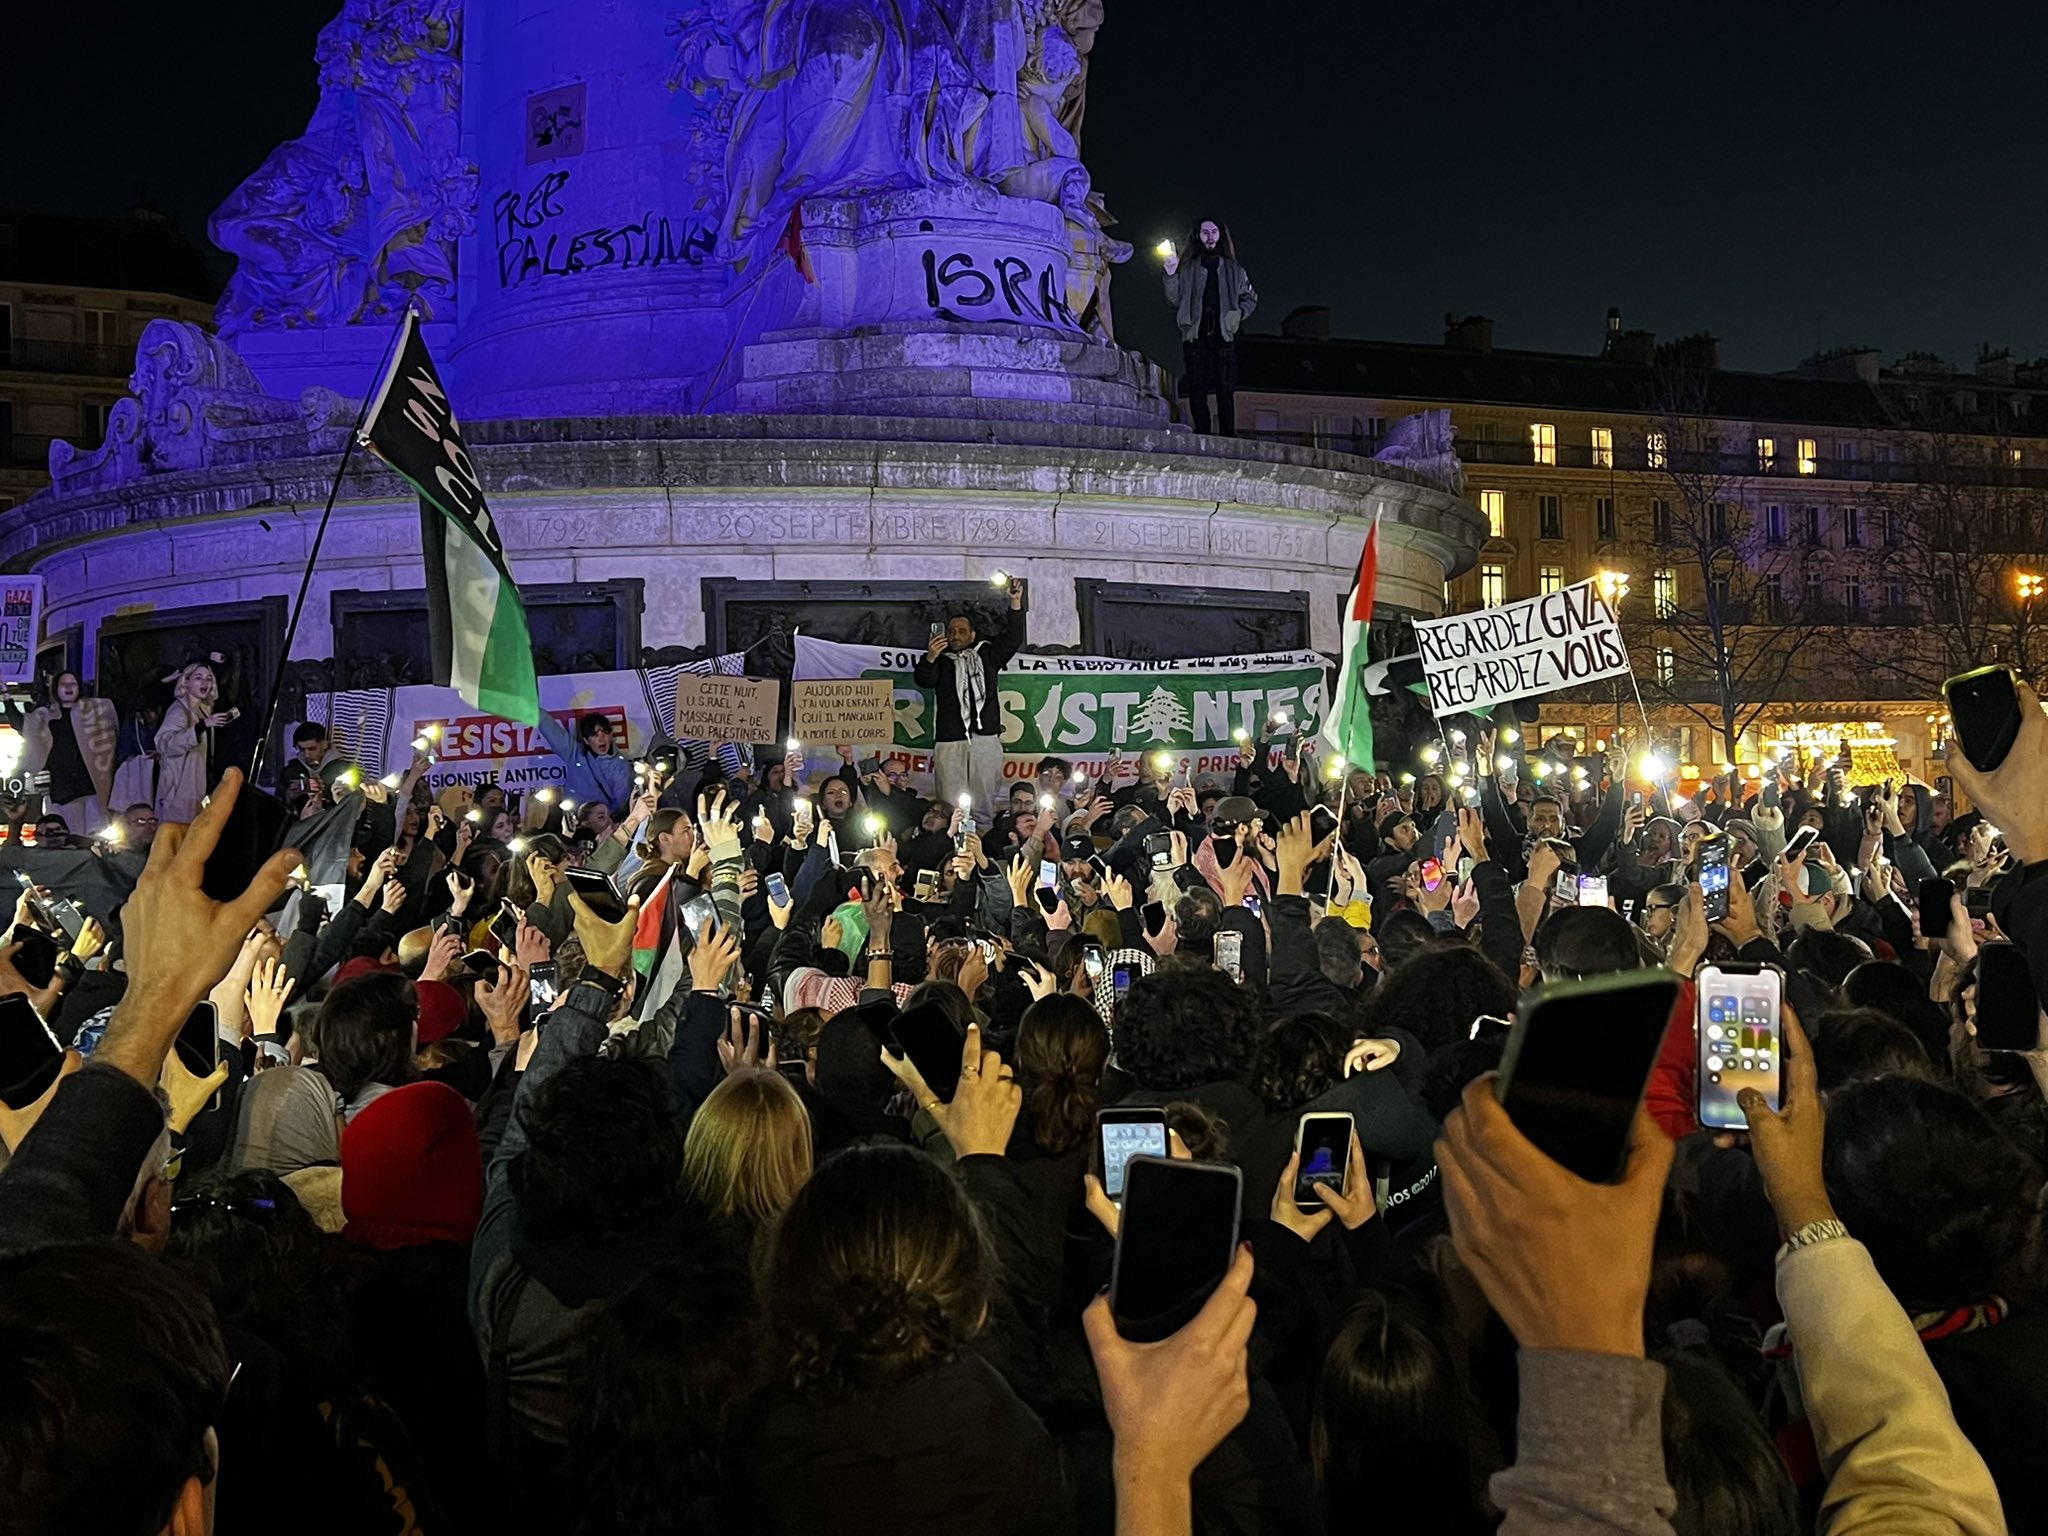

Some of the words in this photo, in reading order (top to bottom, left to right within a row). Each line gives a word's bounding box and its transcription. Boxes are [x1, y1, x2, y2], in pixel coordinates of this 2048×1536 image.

[493, 170, 571, 250] FREE
[526, 517, 586, 544] 1792
[718, 513, 756, 540] 20
[770, 513, 948, 541] SEPTEMBRE
[961, 516, 1017, 542] 1792
[1094, 520, 1115, 546] 21
[1128, 521, 1257, 553] SEPTEMBRE
[1266, 532, 1304, 559] 1792
[1416, 604, 1543, 664] REGARDEZ
[1540, 580, 1615, 639] GAZA
[12, 630, 28, 642] TUE
[1018, 659, 1048, 671] LA
[1426, 649, 1550, 710] REGARDEZ
[699, 682, 731, 696] CETTE
[737, 699, 746, 710] A
[819, 699, 831, 709] VU
[832, 699, 844, 708] UN
[846, 697, 880, 708] ENFANT
[680, 709, 734, 725] MASSACRÉ
[749, 716, 763, 727] DE
[801, 711, 822, 724] QUI
[825, 712, 836, 723] IL
[838, 711, 885, 723] MANQUAIT
[416, 713, 627, 758] ÉSISTAE
[683, 724, 704, 737] 400
[708, 725, 770, 741] PALESTINIENS
[797, 730, 809, 740] LA
[809, 726, 837, 739] MOITIÉ
[841, 729, 855, 739] DU
[504, 765, 567, 784] ANTICO
